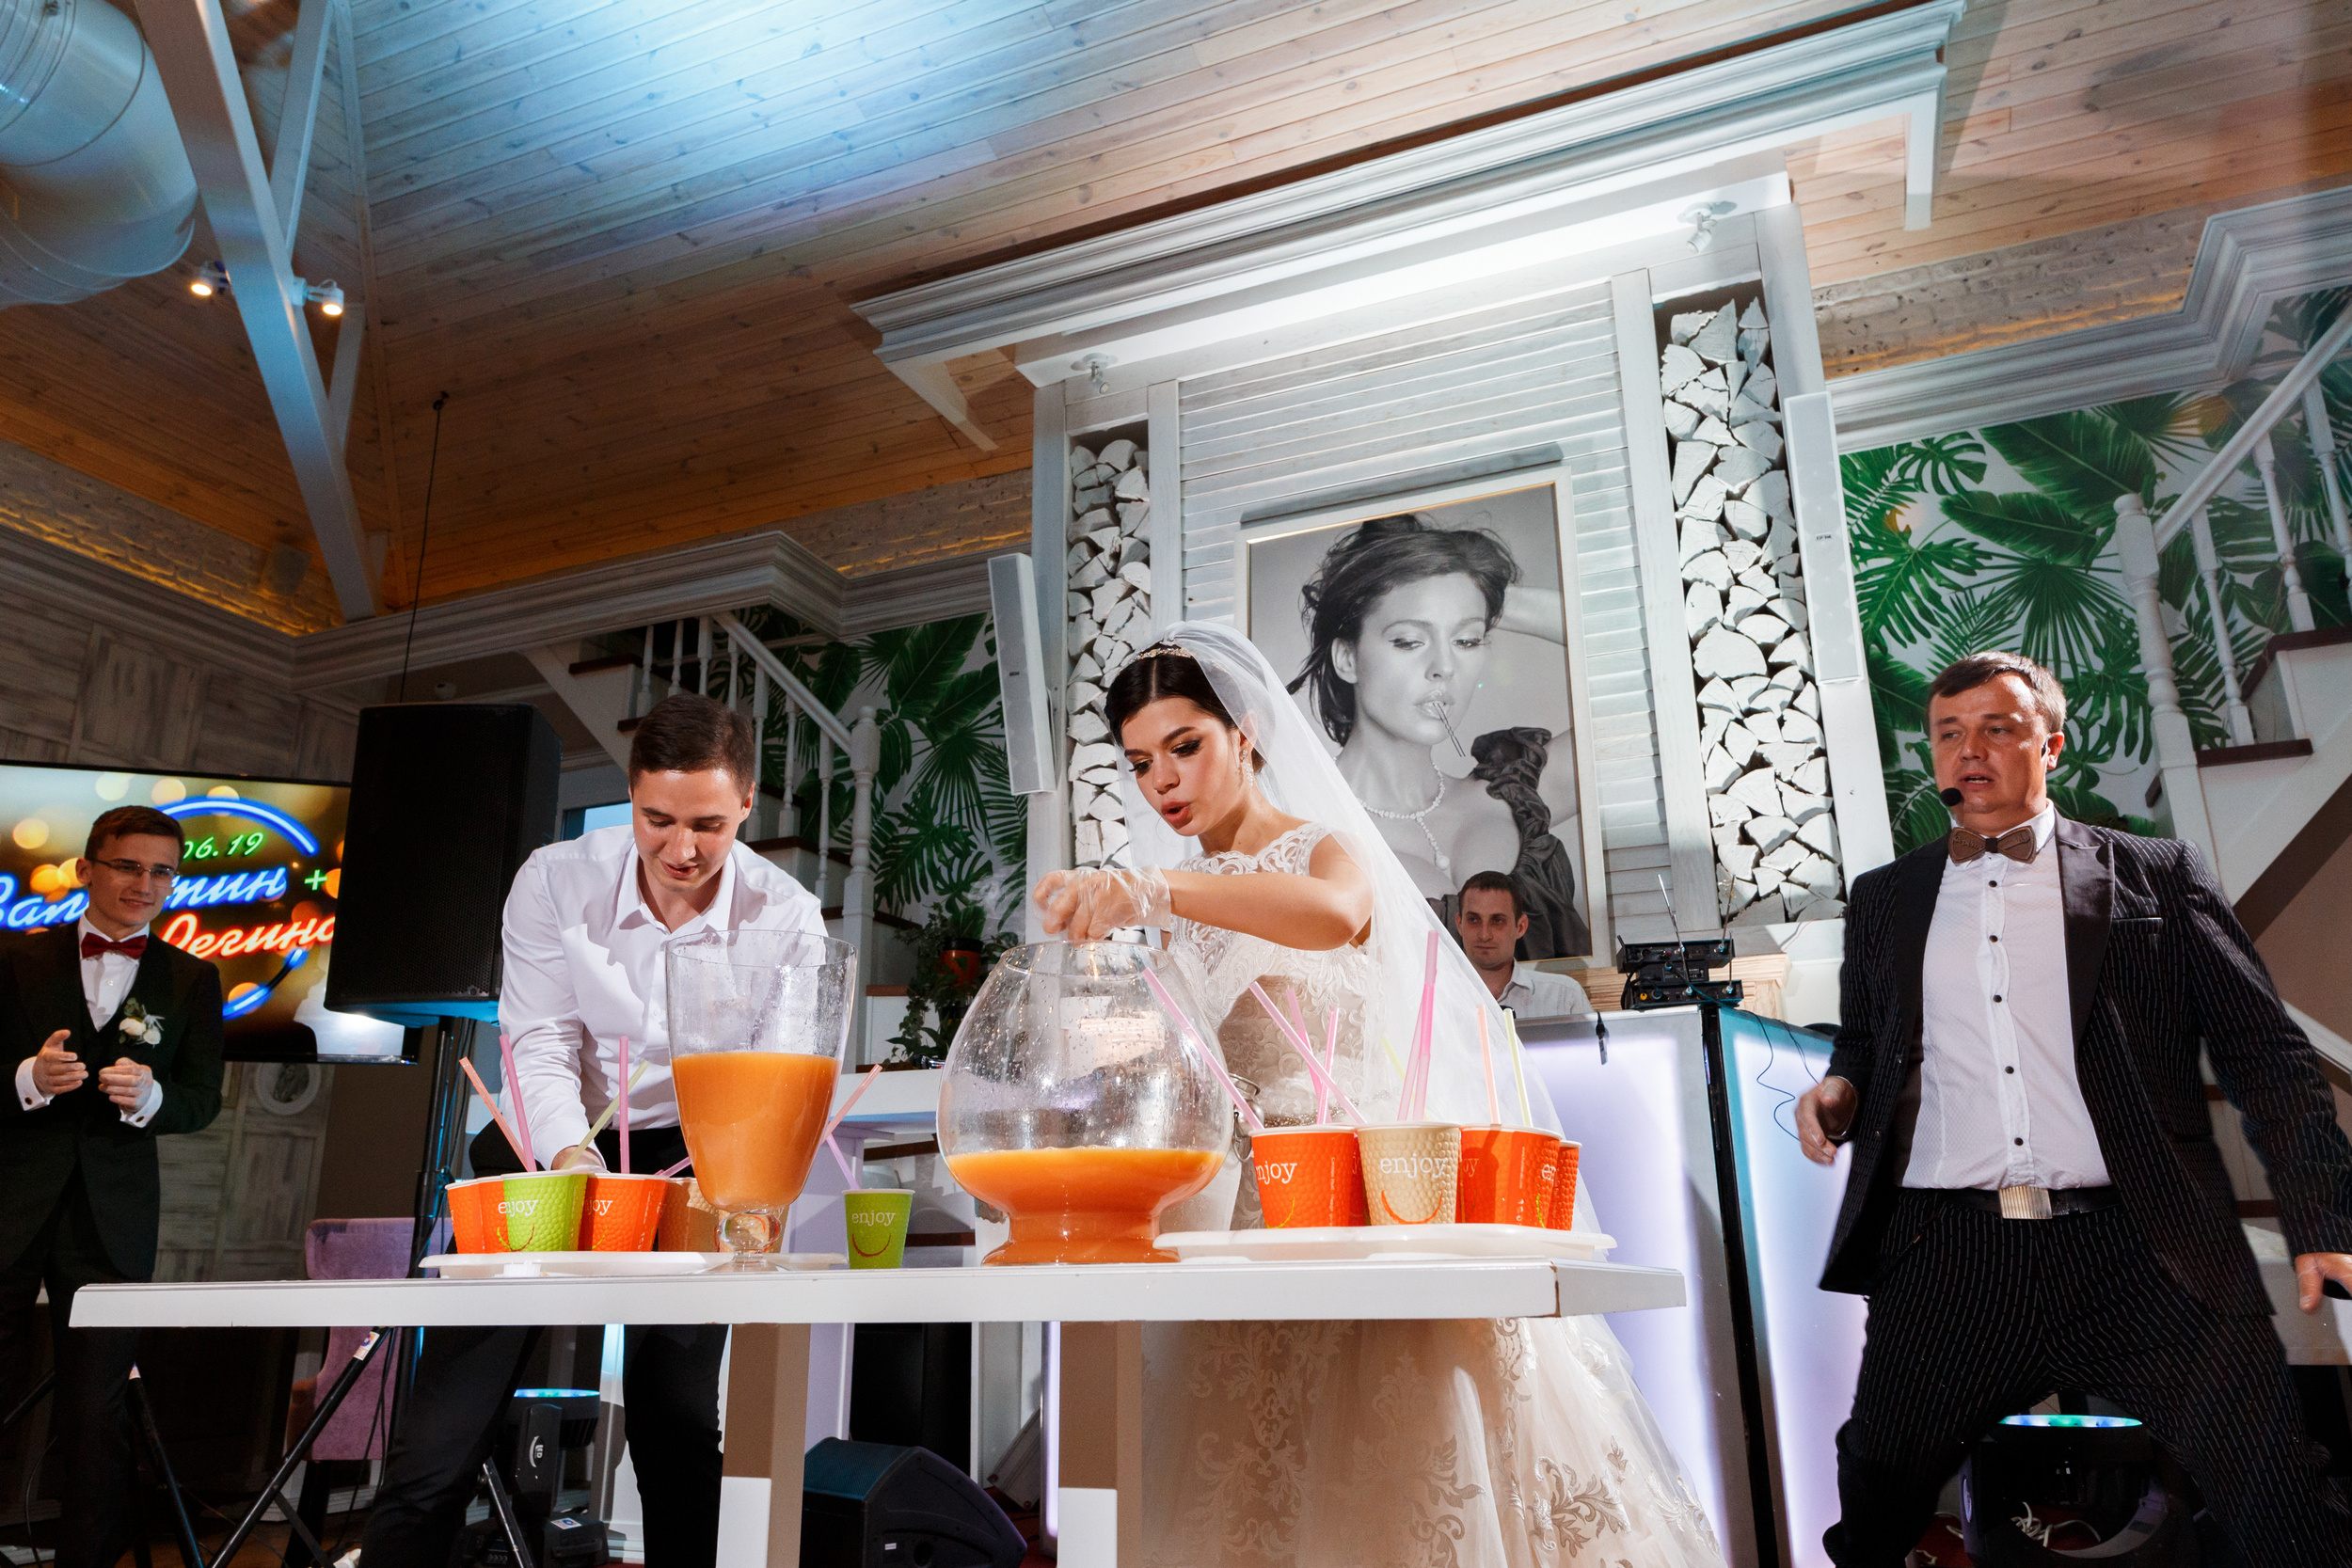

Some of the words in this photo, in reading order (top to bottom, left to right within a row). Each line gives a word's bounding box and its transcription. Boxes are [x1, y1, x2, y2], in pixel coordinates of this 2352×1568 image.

[1256, 1160, 1297, 1185] njoy
[1379, 1152, 1449, 1179] enjoy
[851, 1209, 897, 1227] enjoy
